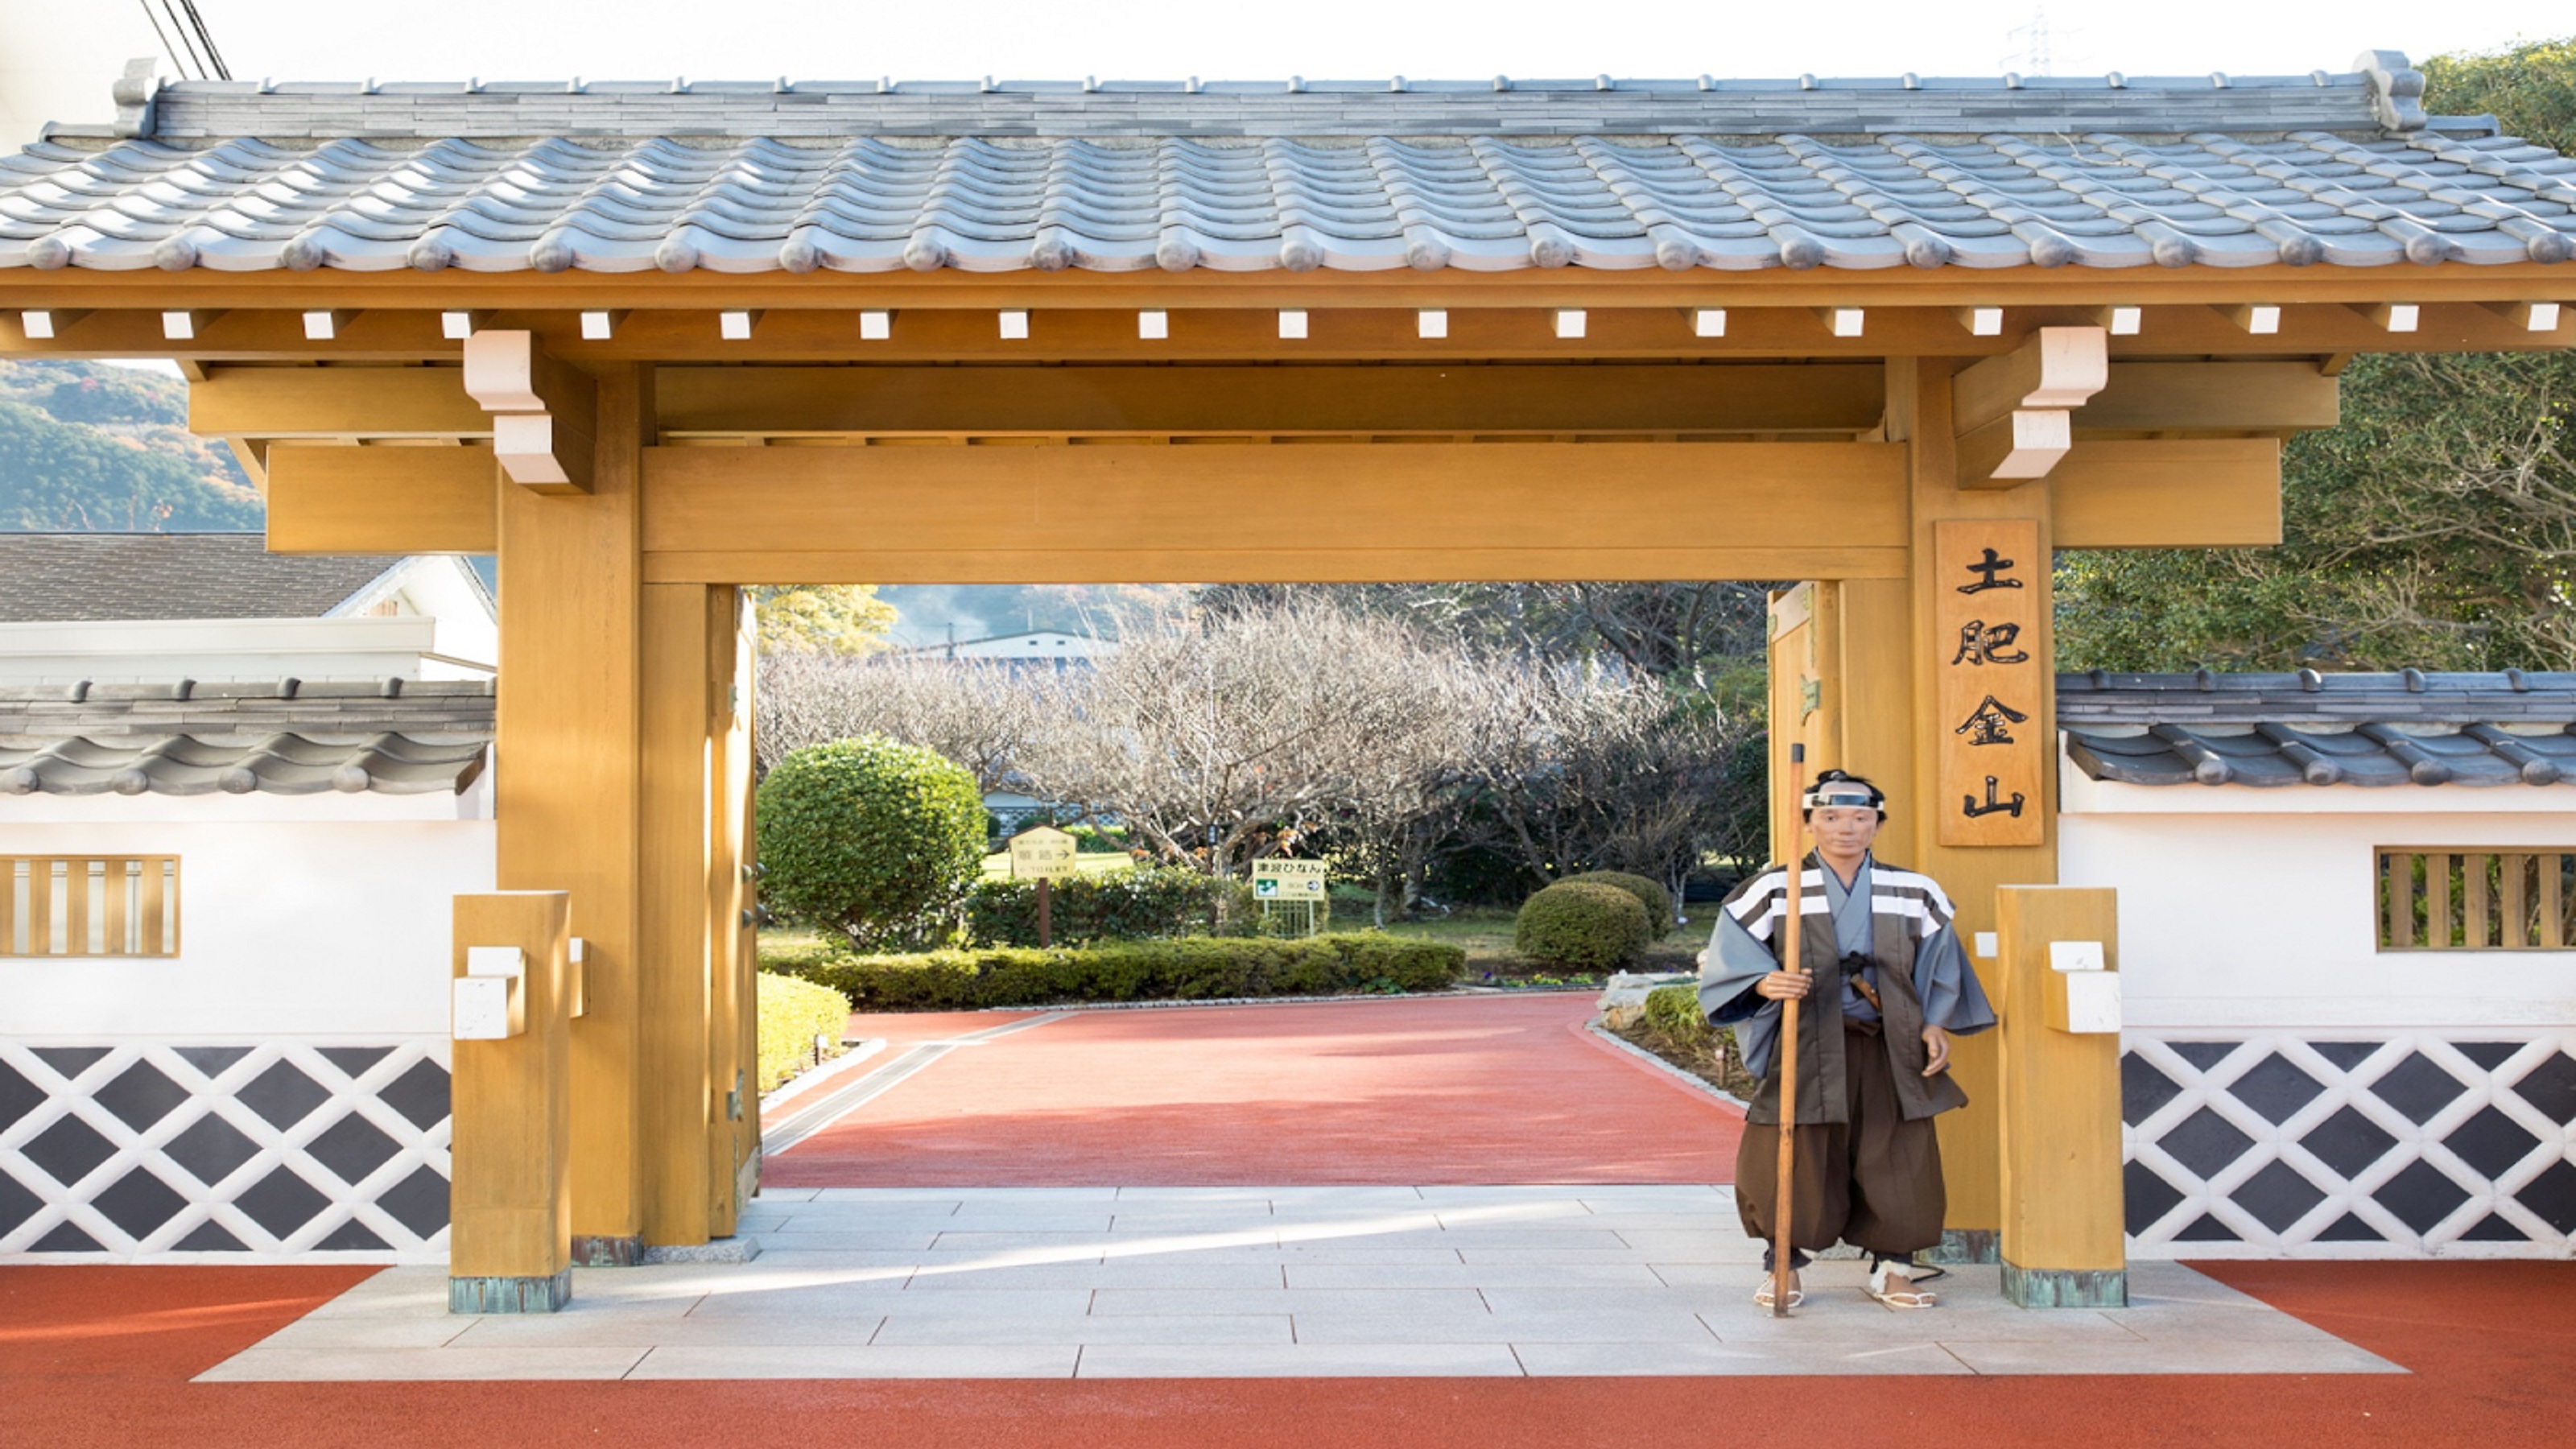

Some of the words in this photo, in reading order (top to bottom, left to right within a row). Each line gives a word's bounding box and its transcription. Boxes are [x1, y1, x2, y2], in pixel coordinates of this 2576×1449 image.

[1951, 547, 2029, 818] 土肥金山
[1257, 862, 1321, 873] 津波ひなん
